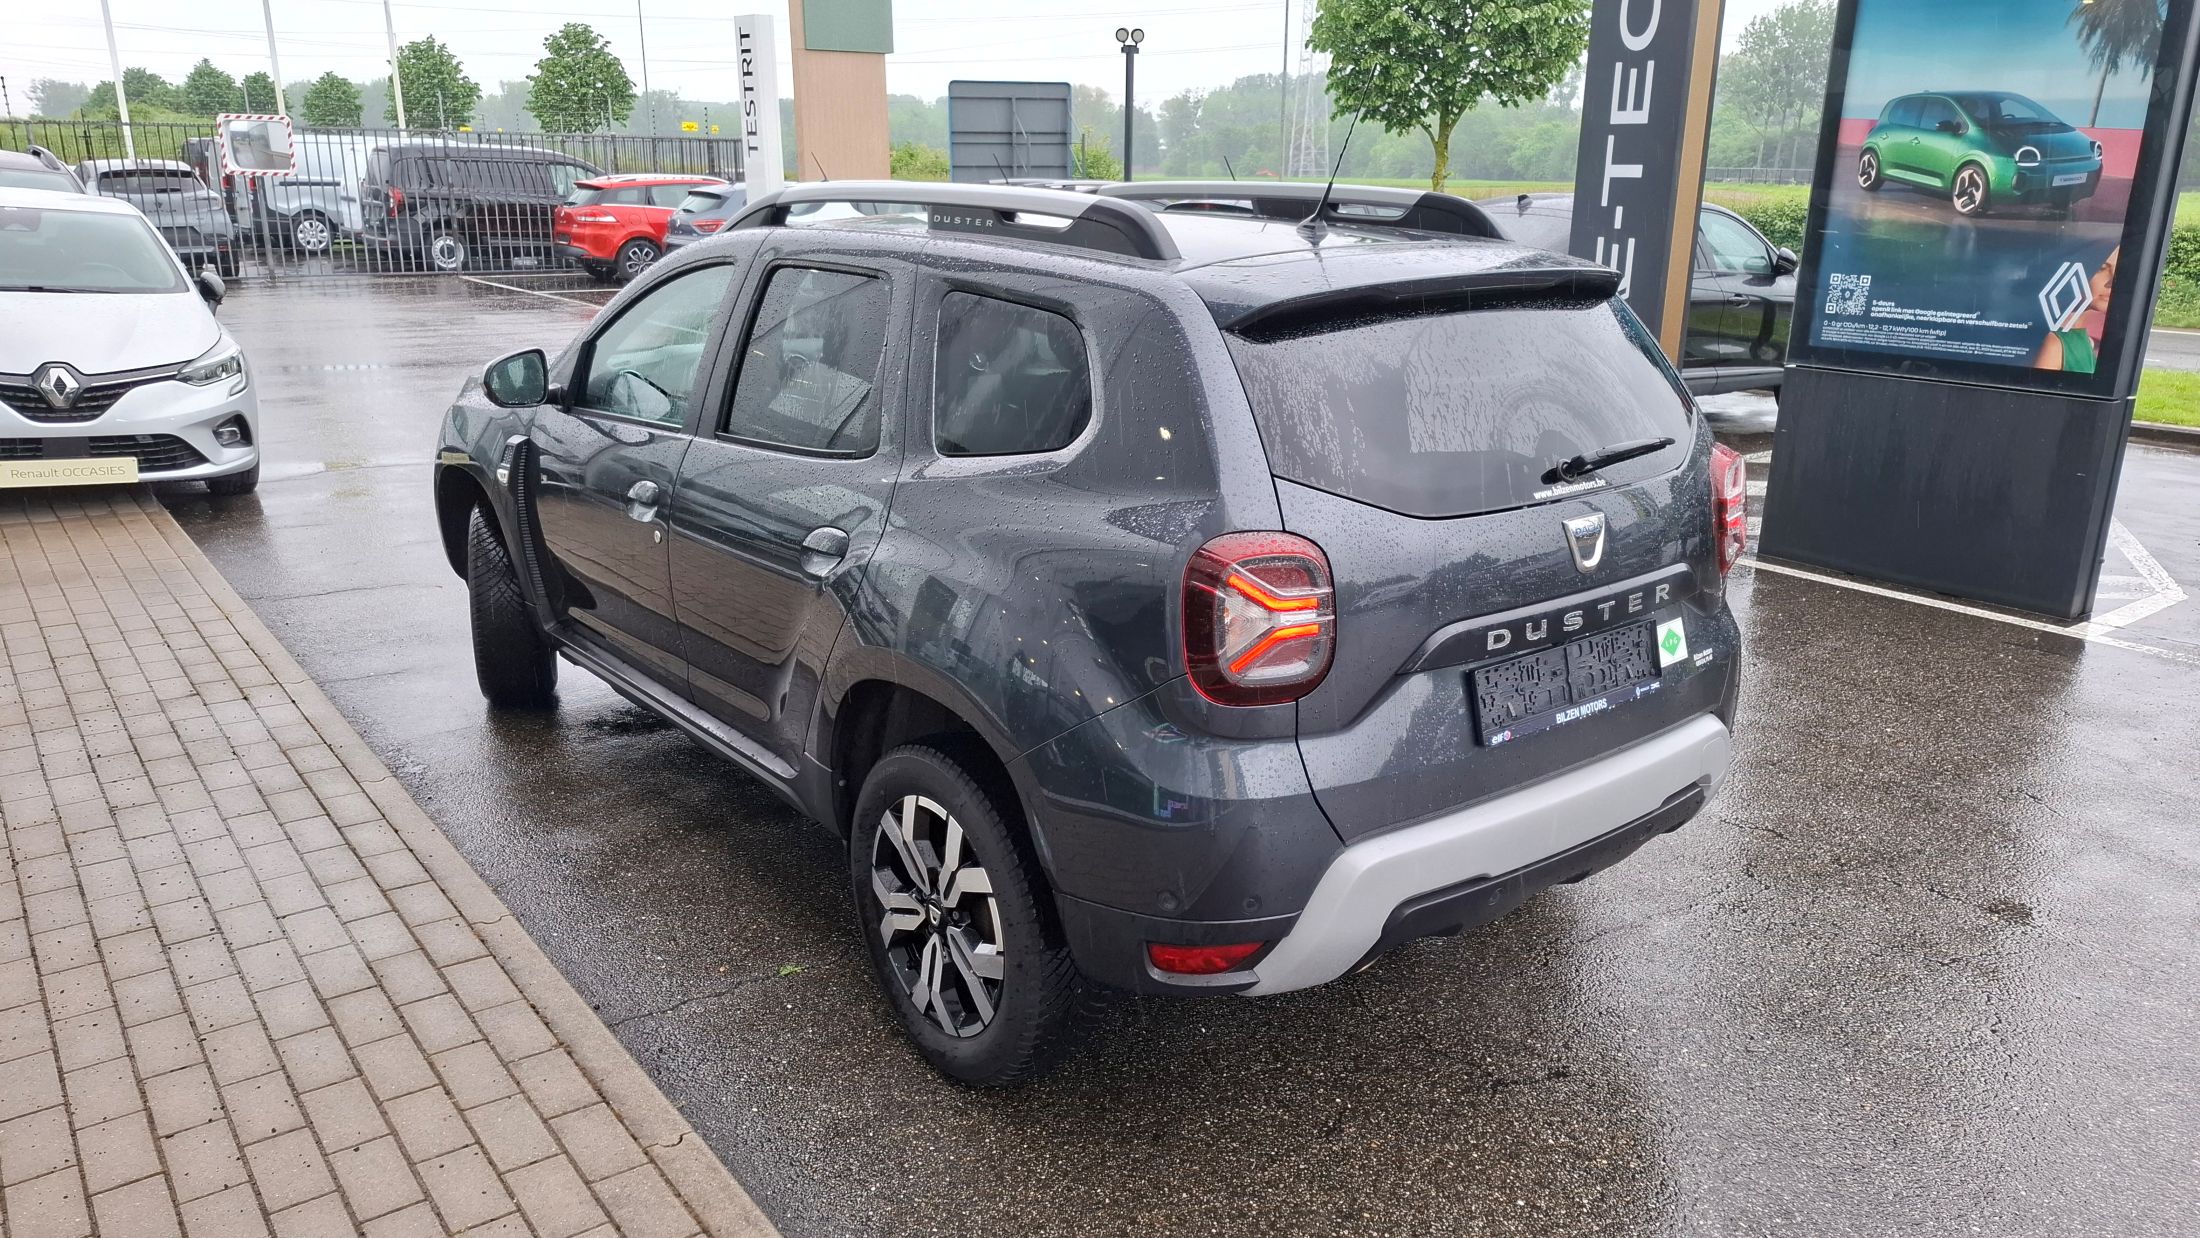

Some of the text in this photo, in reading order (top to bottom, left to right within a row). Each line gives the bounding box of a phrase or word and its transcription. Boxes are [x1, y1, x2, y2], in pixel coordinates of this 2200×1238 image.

[739, 26, 759, 158] TESTRIT
[933, 214, 995, 227] DUSTER
[1915, 309, 1937, 317] Google
[11, 465, 126, 479] Renault OCCASIES
[1533, 477, 1606, 500] www.bilzenmotors.be
[1486, 583, 1671, 651] DUSTER
[1556, 698, 1608, 724] BILZEN MOTORS
